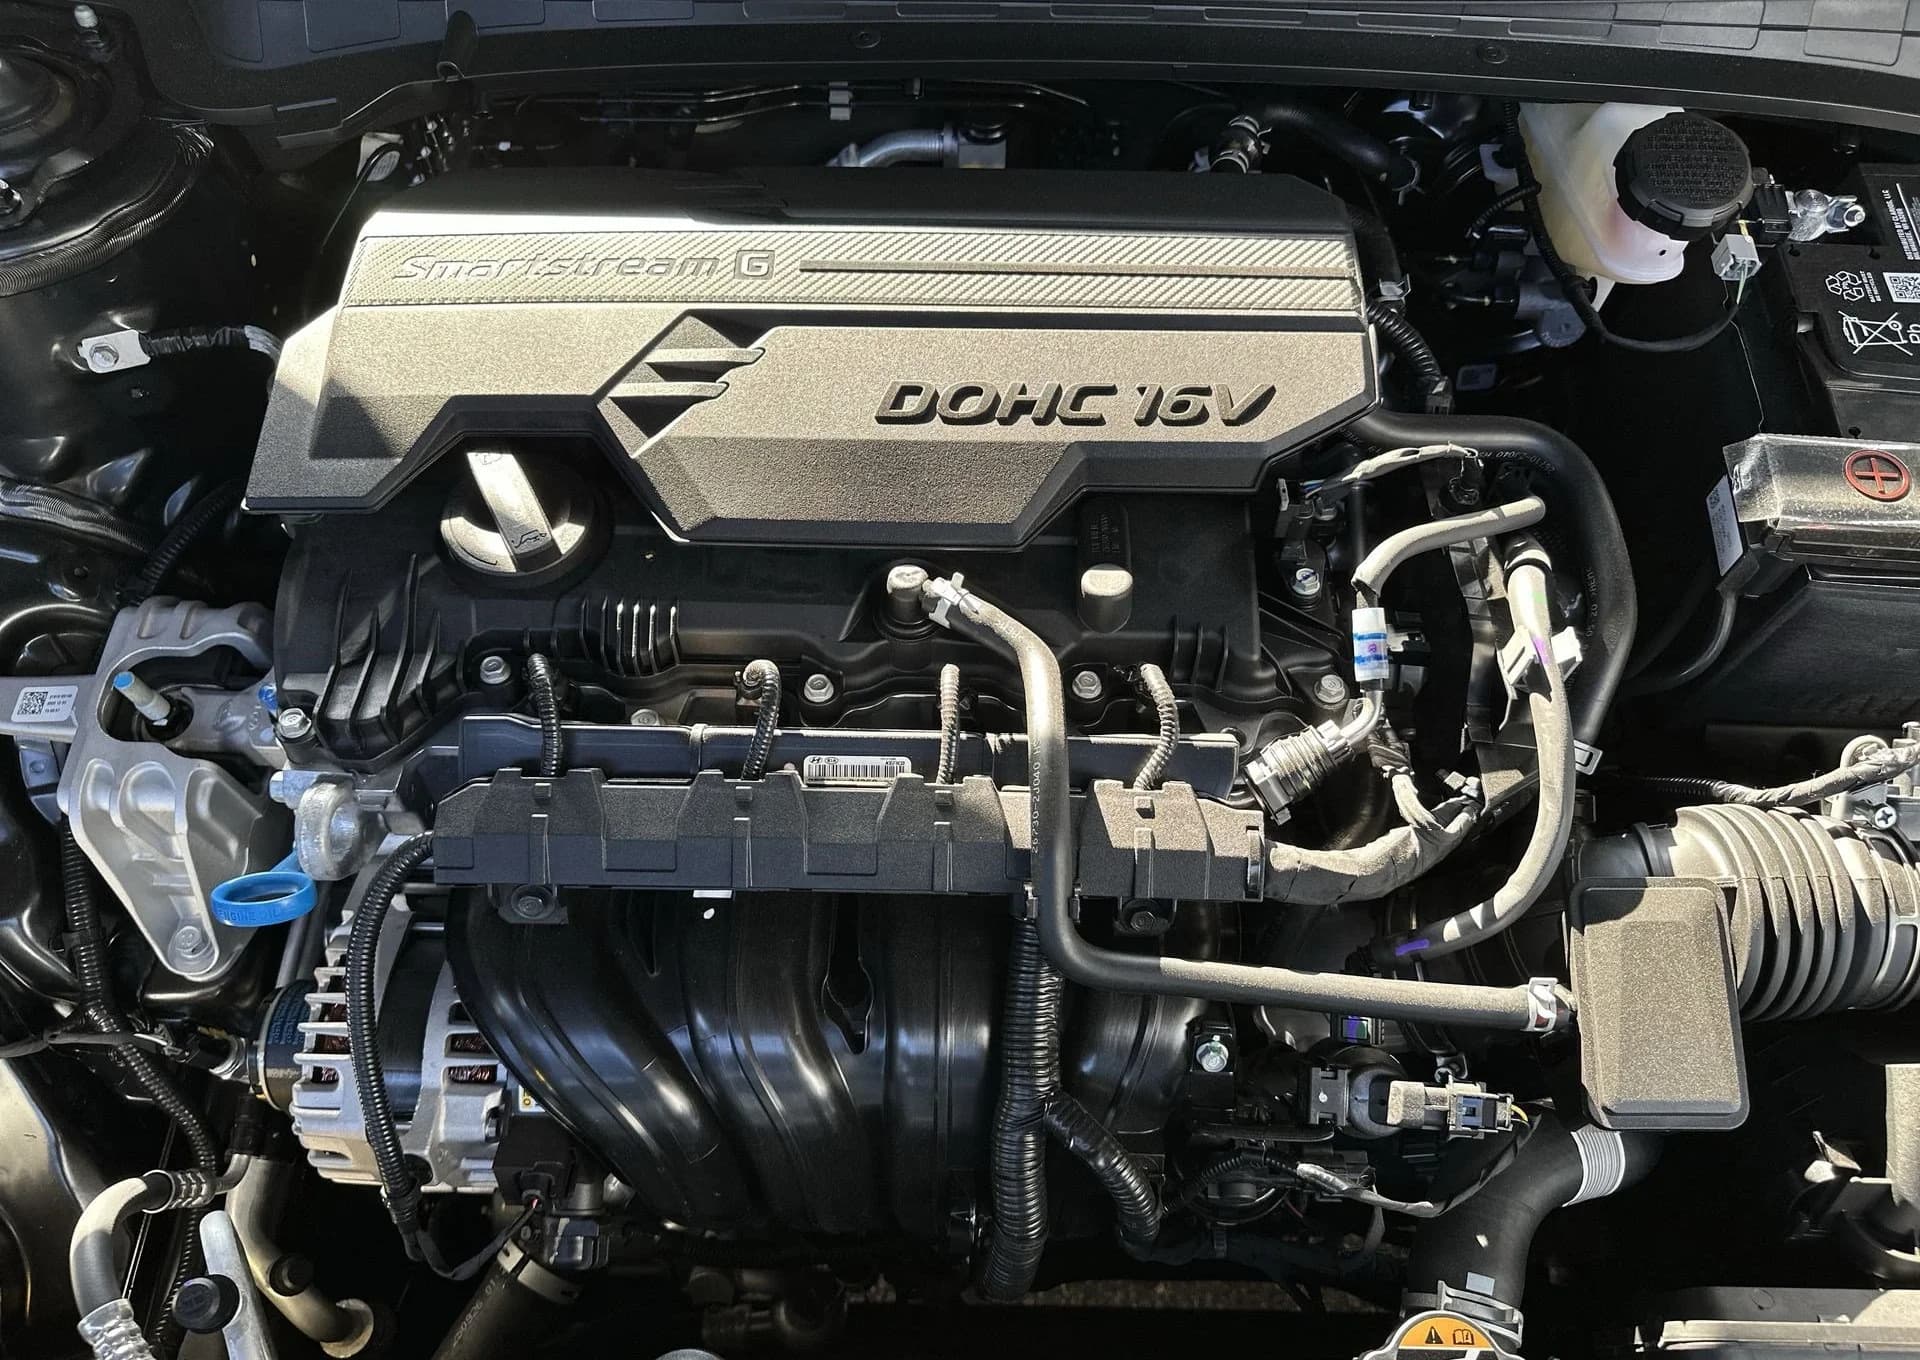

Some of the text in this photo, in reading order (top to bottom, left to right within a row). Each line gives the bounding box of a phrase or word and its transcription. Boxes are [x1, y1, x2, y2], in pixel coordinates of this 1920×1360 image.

[394, 252, 773, 279] Smartstream G
[874, 381, 1277, 427] DOHC 16V
